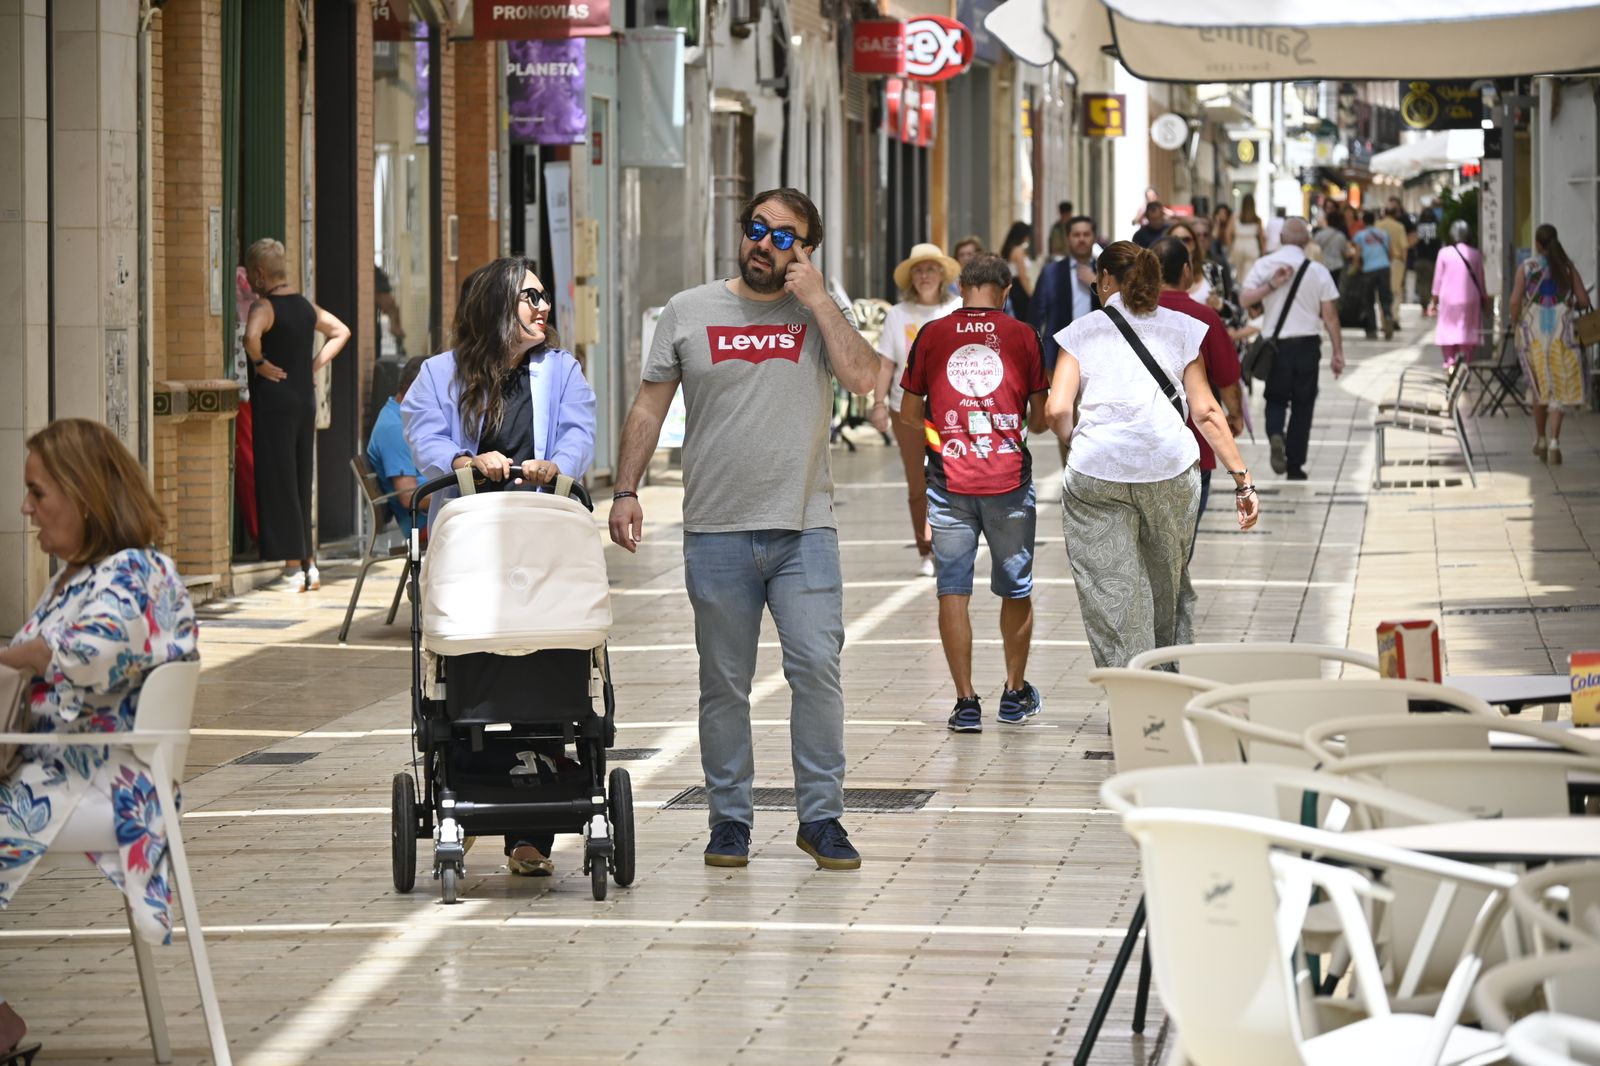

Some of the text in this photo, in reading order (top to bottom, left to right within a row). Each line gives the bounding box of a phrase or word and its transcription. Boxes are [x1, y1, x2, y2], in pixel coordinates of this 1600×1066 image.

[493, 4, 589, 20] PRONOVIAS
[506, 62, 579, 77] PLANETA
[956, 322, 996, 333] LARO
